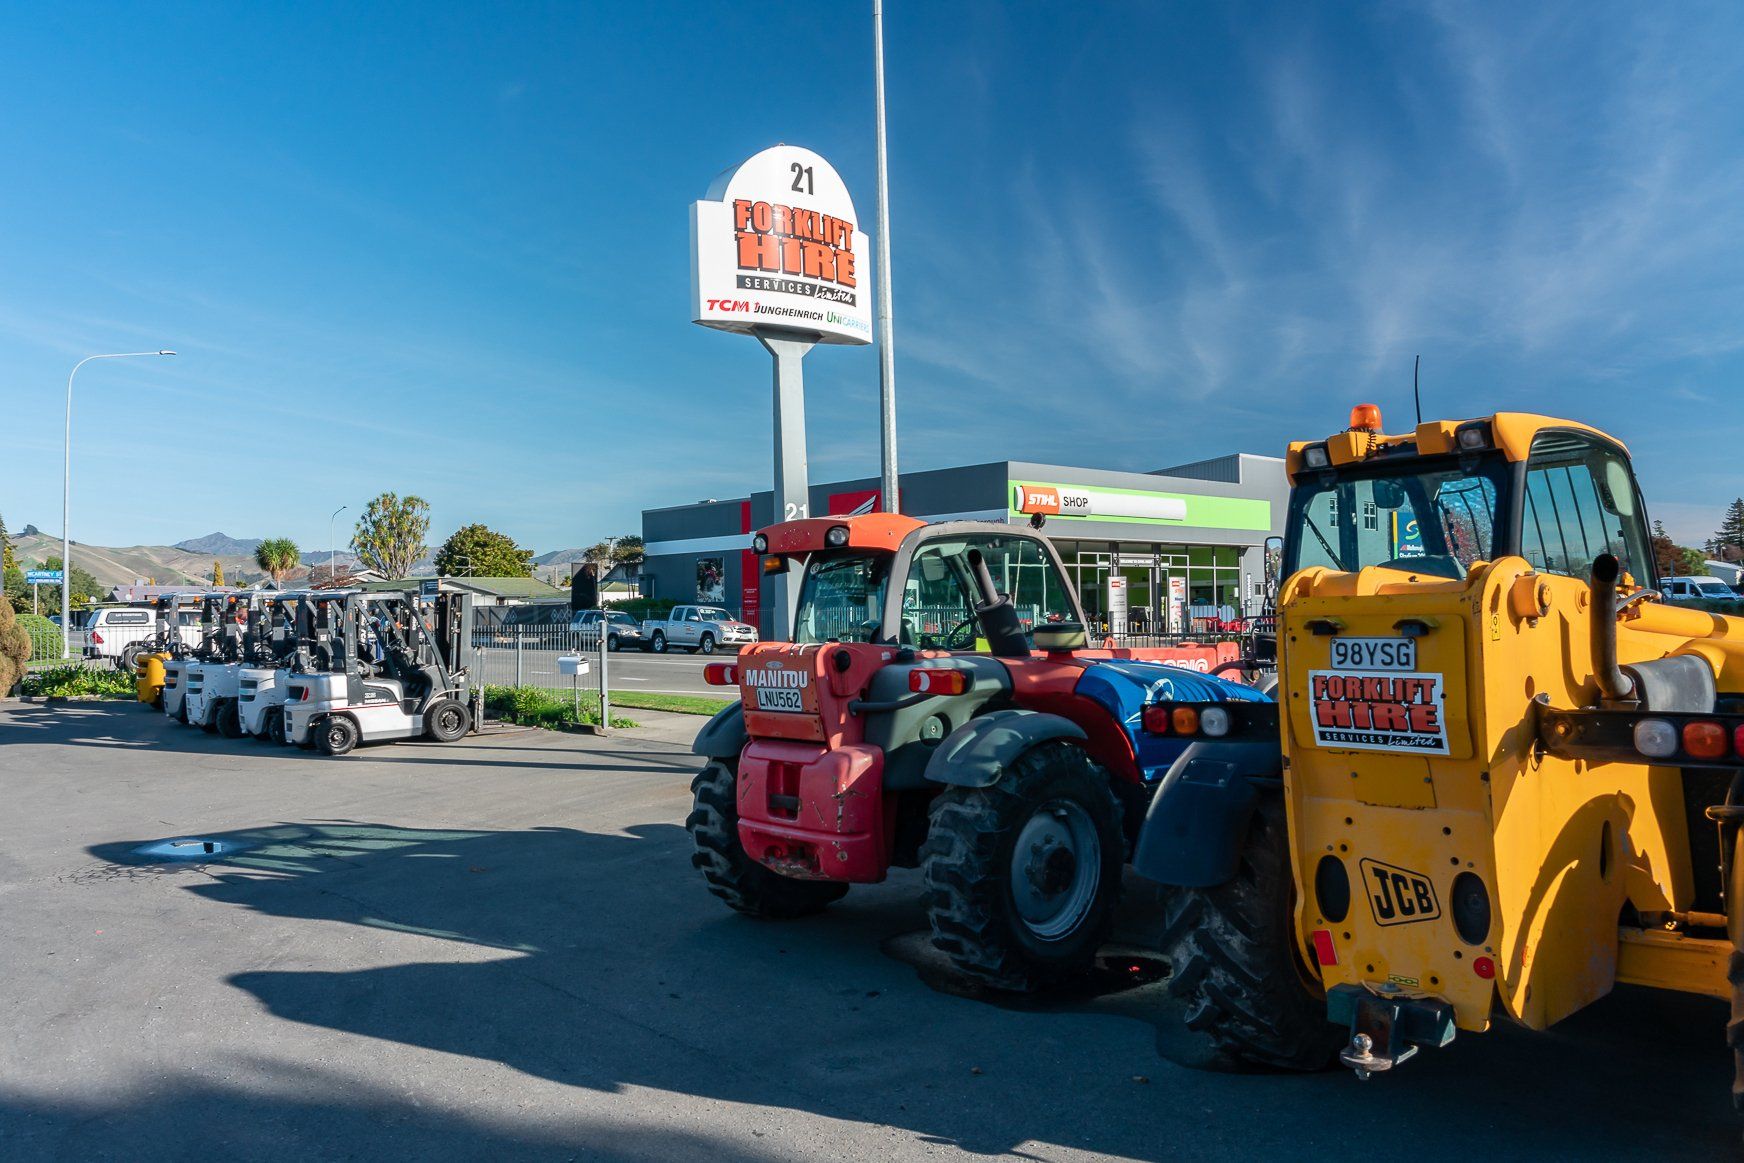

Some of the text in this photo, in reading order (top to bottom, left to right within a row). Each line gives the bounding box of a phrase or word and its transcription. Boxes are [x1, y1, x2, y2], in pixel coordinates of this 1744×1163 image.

[790, 162, 814, 196] 21
[733, 198, 854, 250] FORKLIFT
[735, 231, 857, 288] HIRE
[745, 277, 811, 295] SERVICES
[707, 299, 750, 312] TCM
[754, 302, 824, 321] JUNGHEINRICH
[785, 502, 808, 522] 21
[1028, 493, 1089, 508] STIHL SHOP
[1335, 642, 1411, 666] 98YSG
[746, 669, 808, 688] MANITOU
[1312, 675, 1437, 704] FORKLIFT
[757, 690, 801, 708] LNU562
[1313, 700, 1441, 734] HIRE
[1325, 732, 1436, 746] SERVICES Limited
[1371, 867, 1434, 919] JCB
